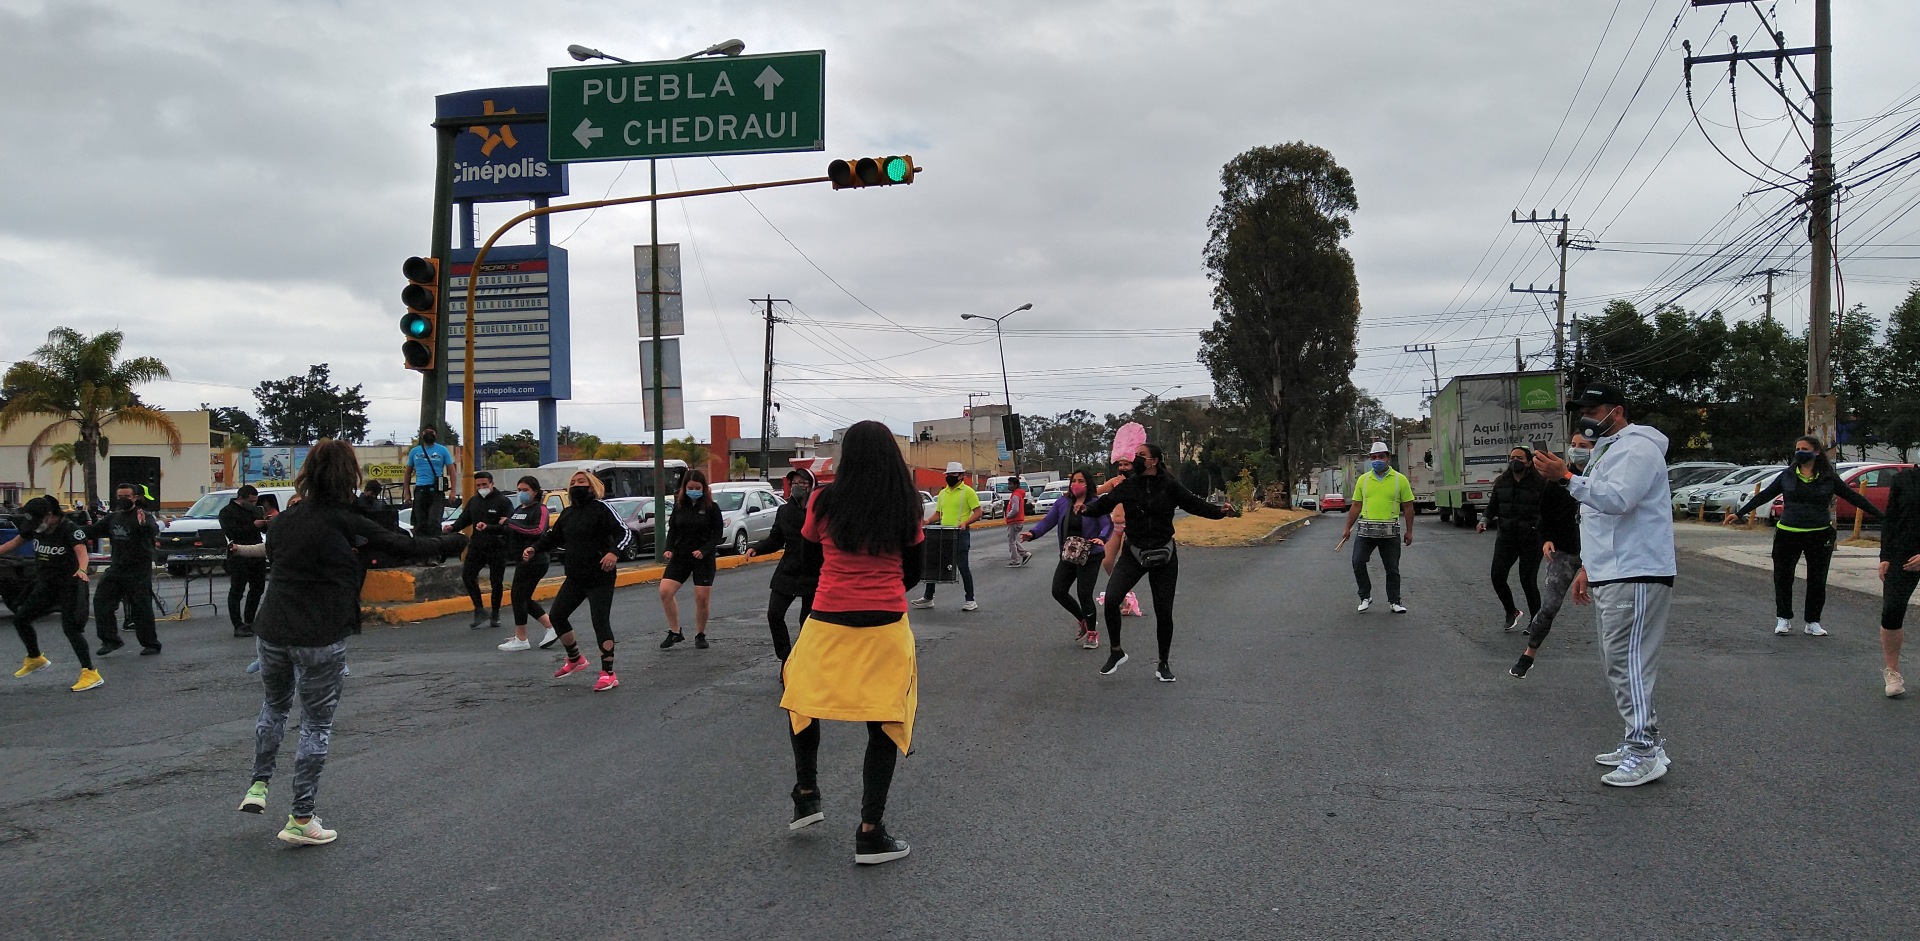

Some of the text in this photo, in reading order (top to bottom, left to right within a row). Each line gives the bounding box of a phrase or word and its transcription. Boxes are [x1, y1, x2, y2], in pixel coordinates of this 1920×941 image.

[583, 71, 735, 105] PUEBLA
[623, 112, 797, 146] CHEDRAUI
[453, 157, 548, 184] Cinépolis
[478, 275, 502, 285] STOS
[507, 274, 530, 284] DIAS
[473, 386, 535, 396] w.cinepolis.com
[1473, 421, 1554, 435] Aquí llevamos
[1473, 432, 1554, 446] bienestar 24/7
[33, 539, 66, 555] Dance
